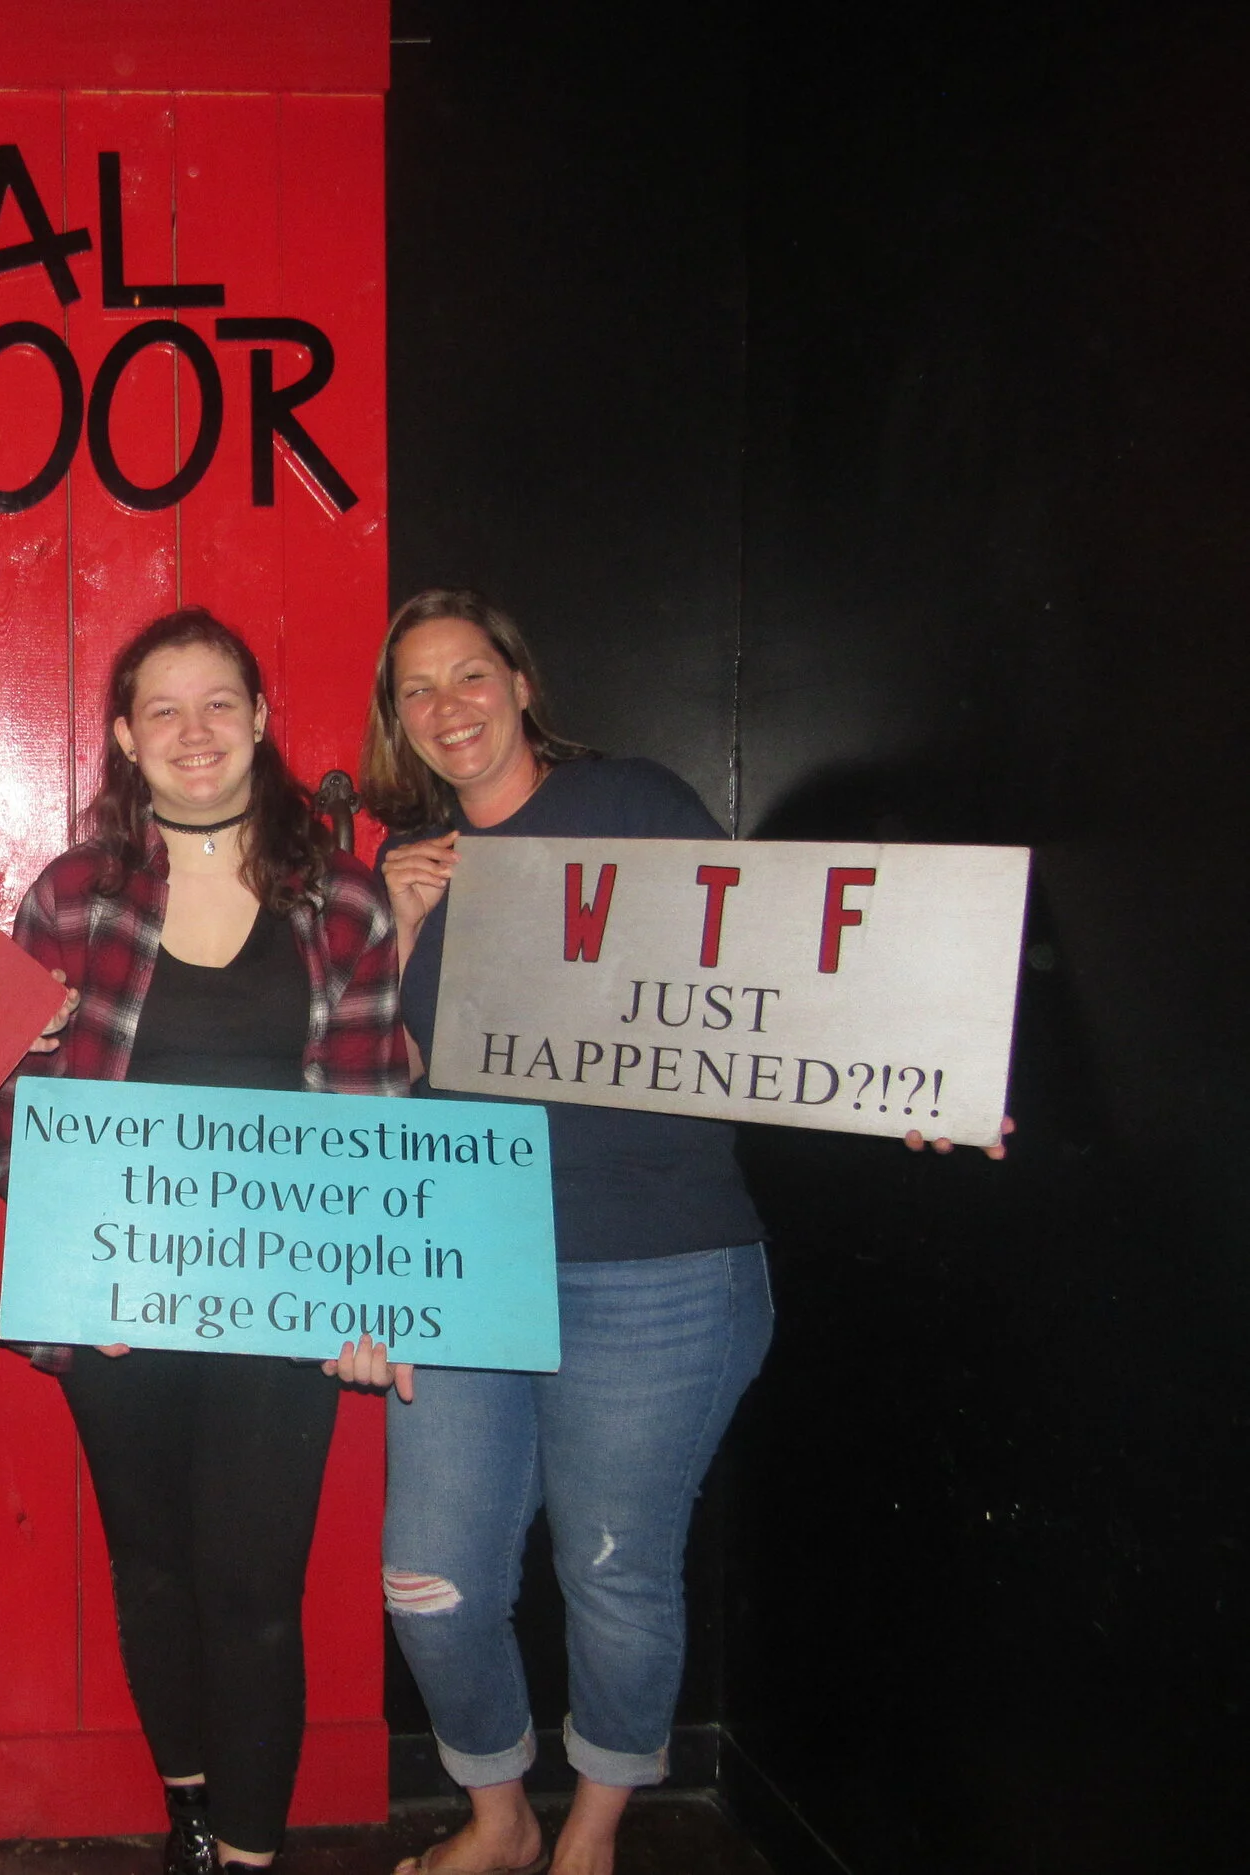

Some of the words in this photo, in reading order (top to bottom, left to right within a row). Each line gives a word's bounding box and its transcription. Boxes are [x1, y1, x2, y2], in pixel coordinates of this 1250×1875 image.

[620, 979, 781, 1033] JUST
[478, 1031, 945, 1119] HAPPENED?!?!
[24, 1104, 165, 1149] Never
[175, 1112, 535, 1168] Underestimate
[121, 1165, 199, 1208] the
[211, 1170, 370, 1216] Power
[382, 1178, 436, 1219] of
[91, 1221, 246, 1277] Stupid
[258, 1230, 412, 1285] People
[424, 1238, 464, 1280] in
[109, 1282, 254, 1340] Large
[268, 1291, 443, 1348] Groups
